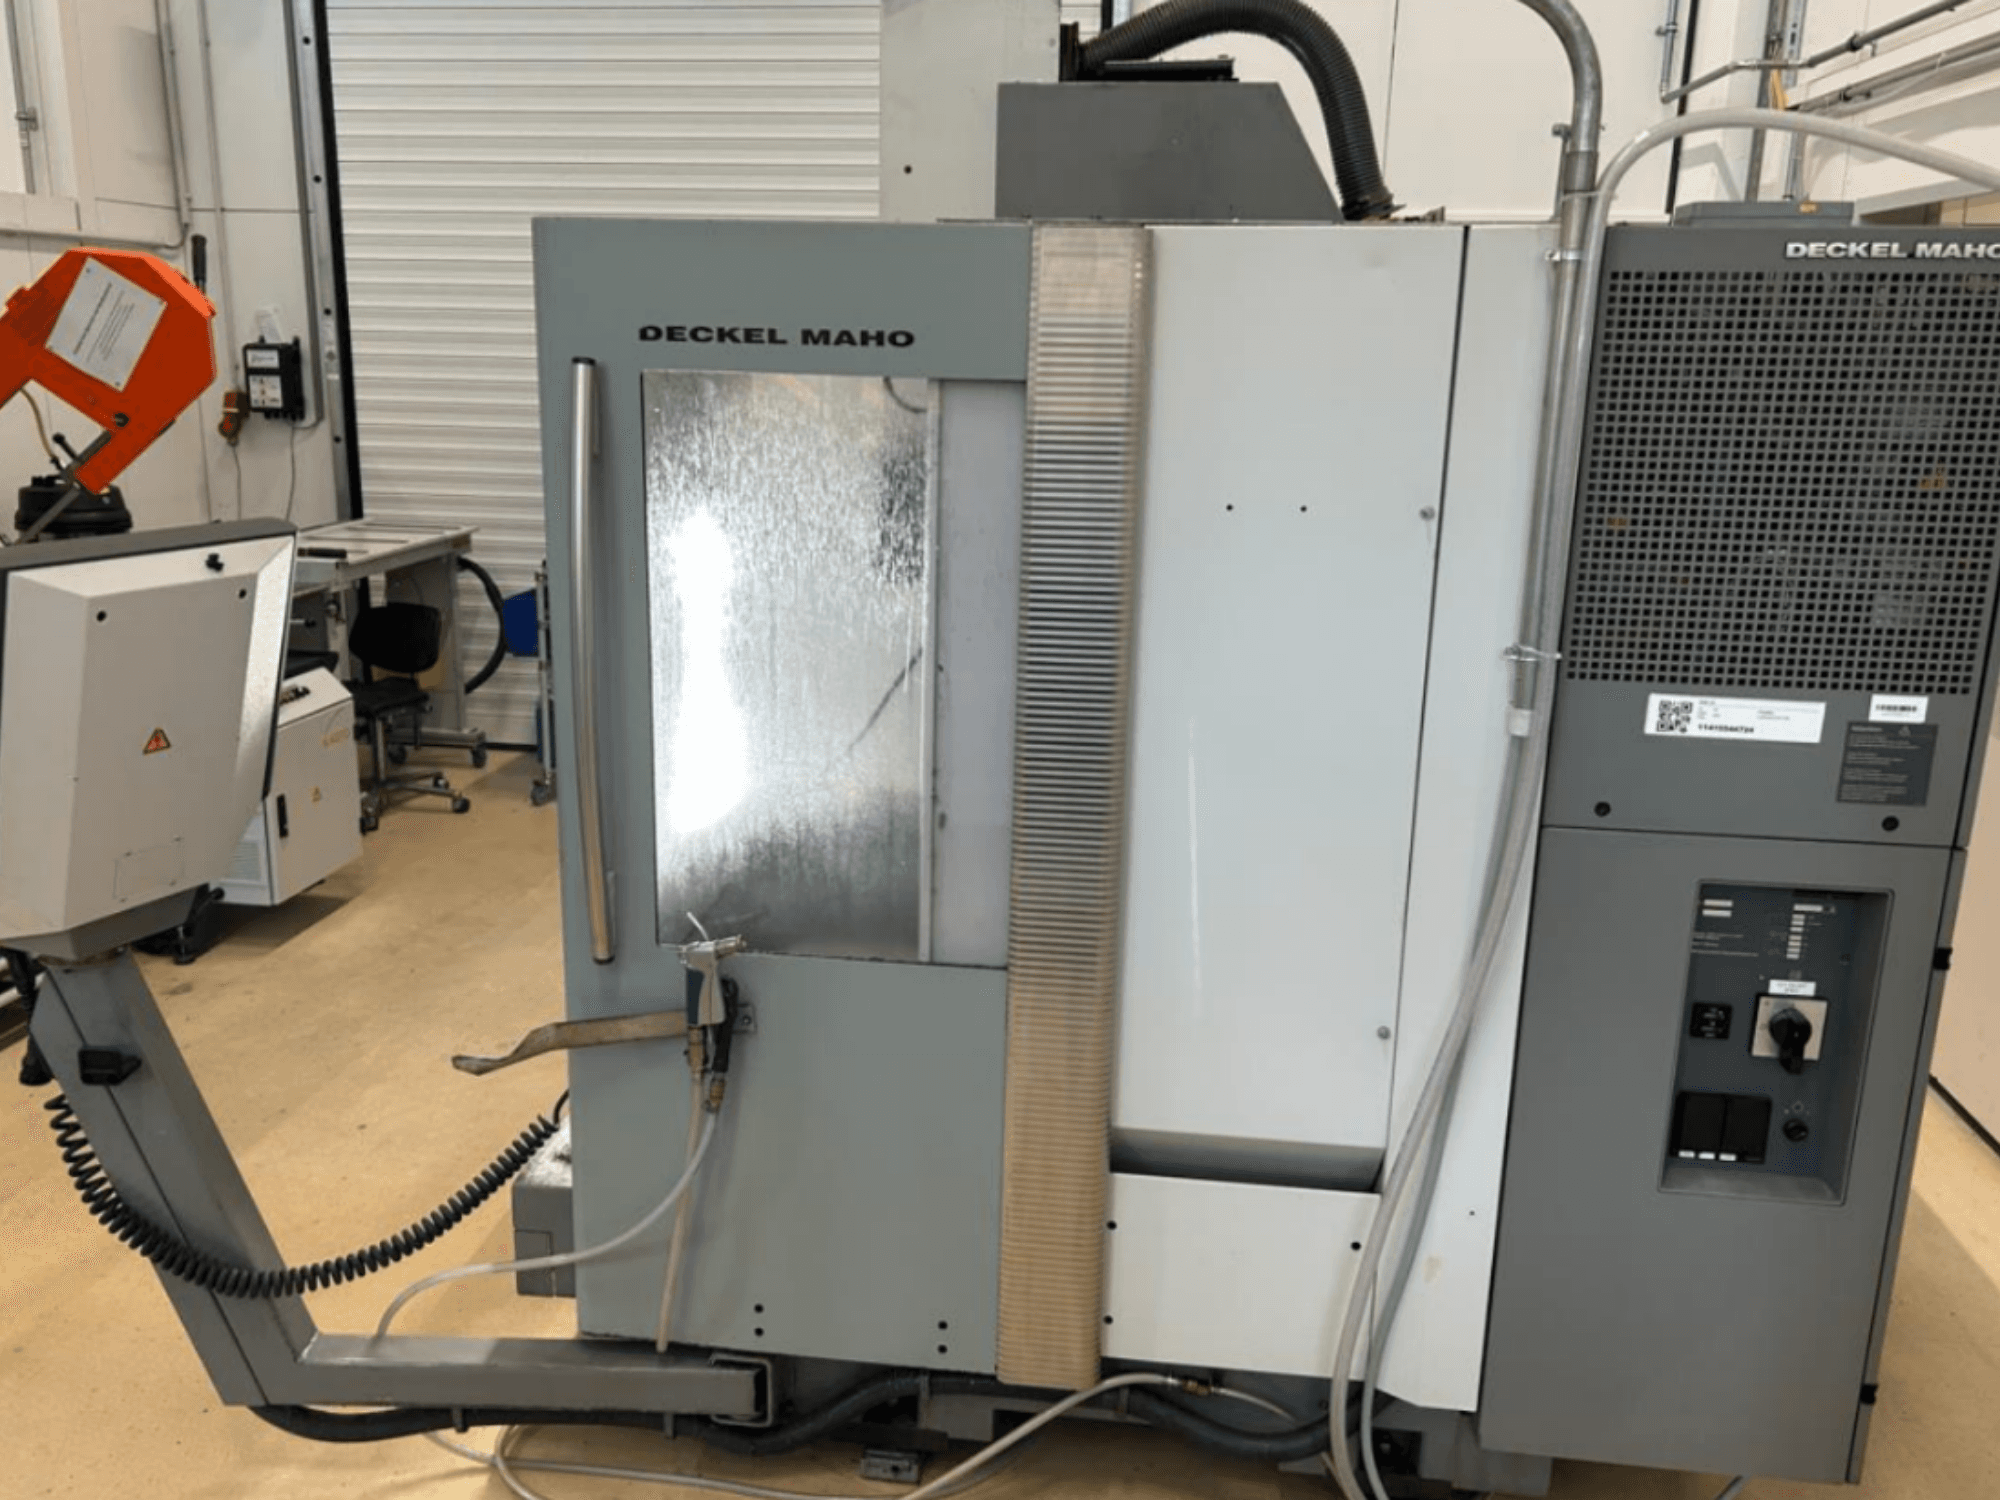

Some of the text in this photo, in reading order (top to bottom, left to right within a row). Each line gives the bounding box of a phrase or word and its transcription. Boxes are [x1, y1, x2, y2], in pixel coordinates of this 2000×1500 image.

[1785, 241, 1907, 259] DECKEL
[638, 324, 916, 348] DECKEL MAHO
